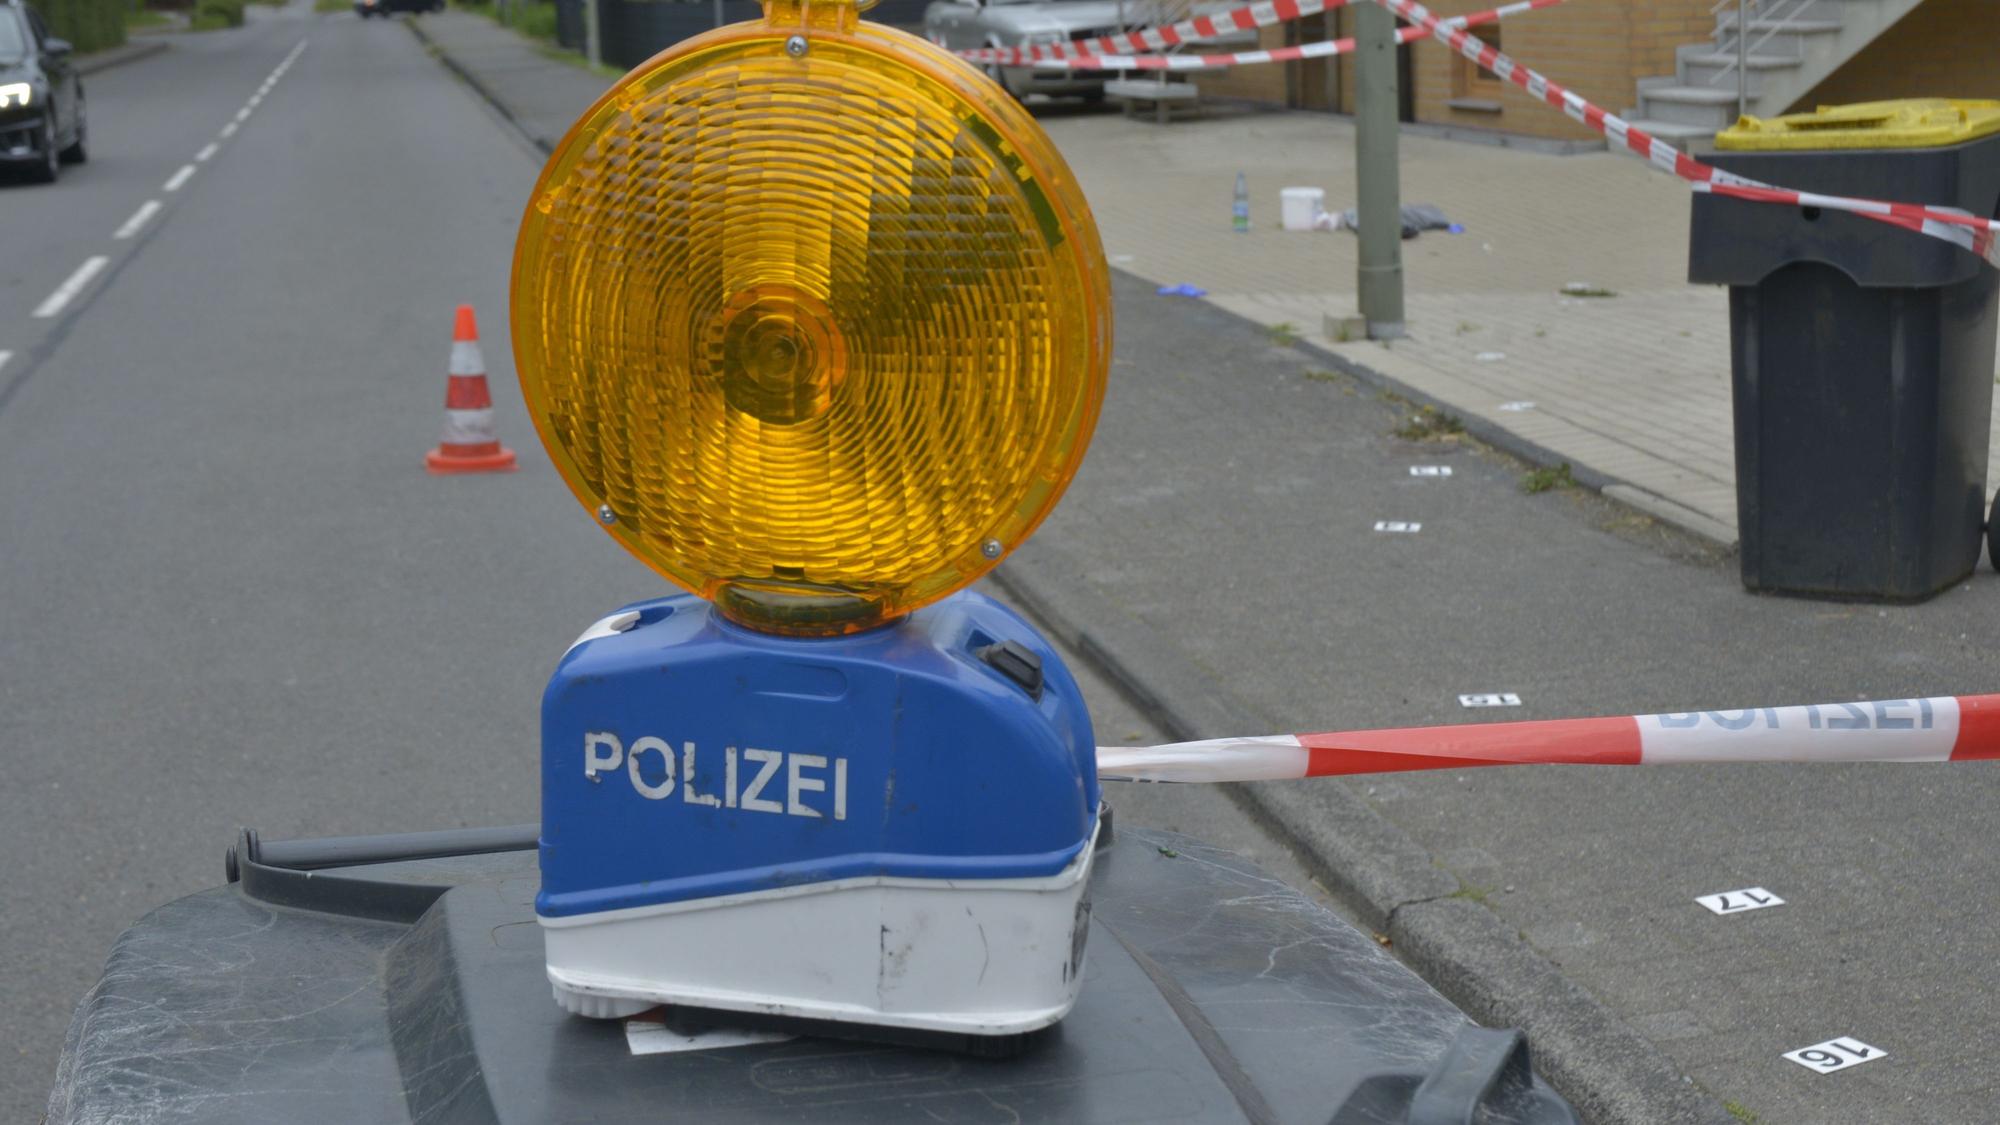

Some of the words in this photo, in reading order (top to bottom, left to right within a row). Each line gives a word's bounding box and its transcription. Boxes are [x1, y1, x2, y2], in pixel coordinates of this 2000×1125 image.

[584, 731, 848, 821] POLIZEI
[1719, 891, 1771, 911] 17
[1798, 1042, 1870, 1067] 16
